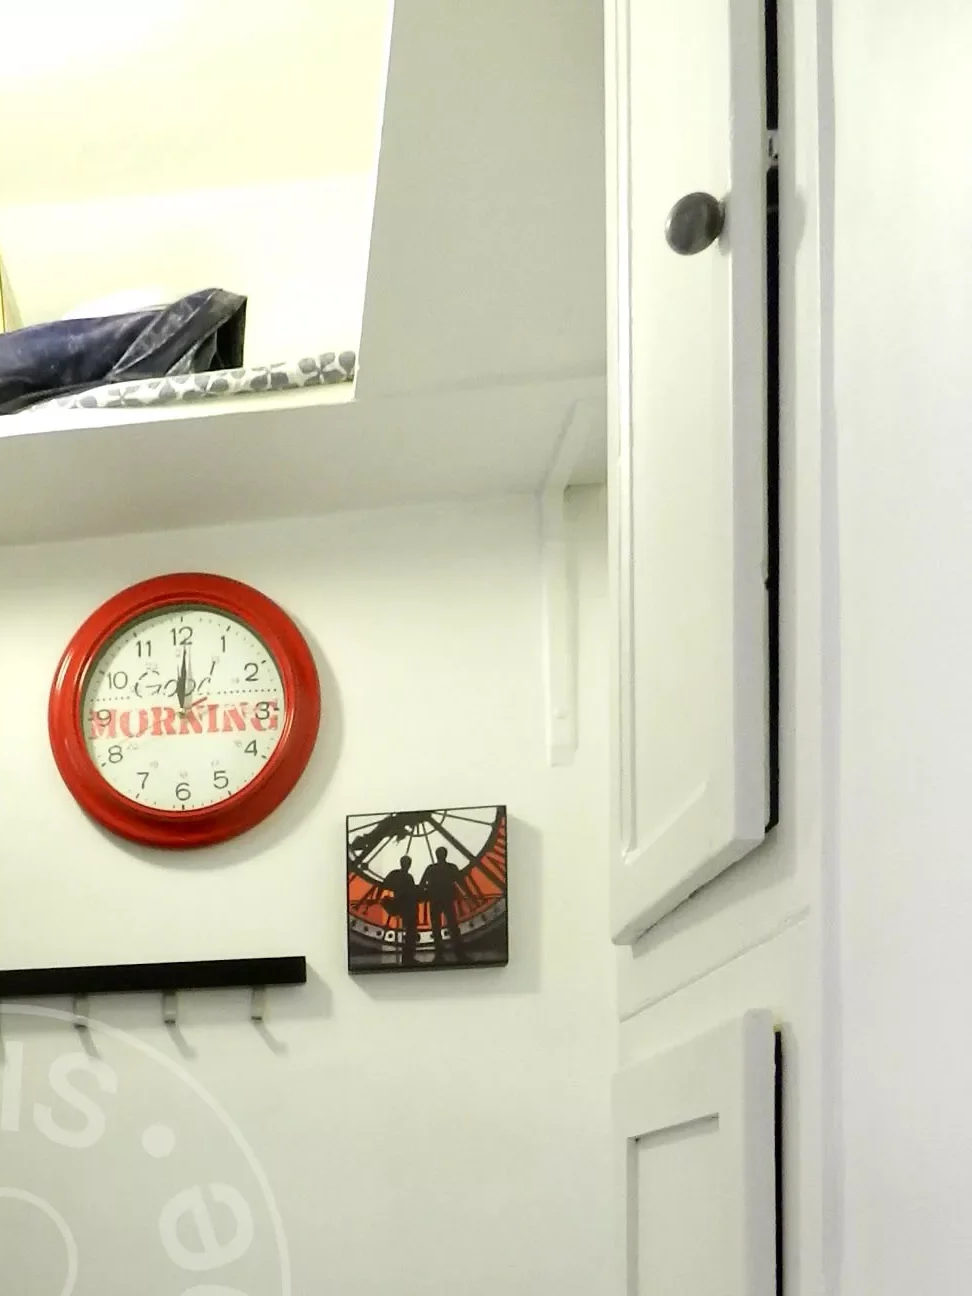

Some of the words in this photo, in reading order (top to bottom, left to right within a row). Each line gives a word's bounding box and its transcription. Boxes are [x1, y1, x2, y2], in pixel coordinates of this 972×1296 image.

[170, 626, 193, 646] 12
[220, 635, 226, 653] 1
[136, 640, 152, 658] 11
[107, 671, 128, 690] 10
[243, 662, 259, 682] 2
[89, 698, 279, 740] MORNING
[96, 709, 112, 727] 9
[254, 701, 270, 721] 3
[108, 745, 124, 764] 8
[243, 739, 258, 757] 4
[136, 771, 150, 789] 7
[212, 770, 229, 789] 5
[175, 782, 191, 801] 6
